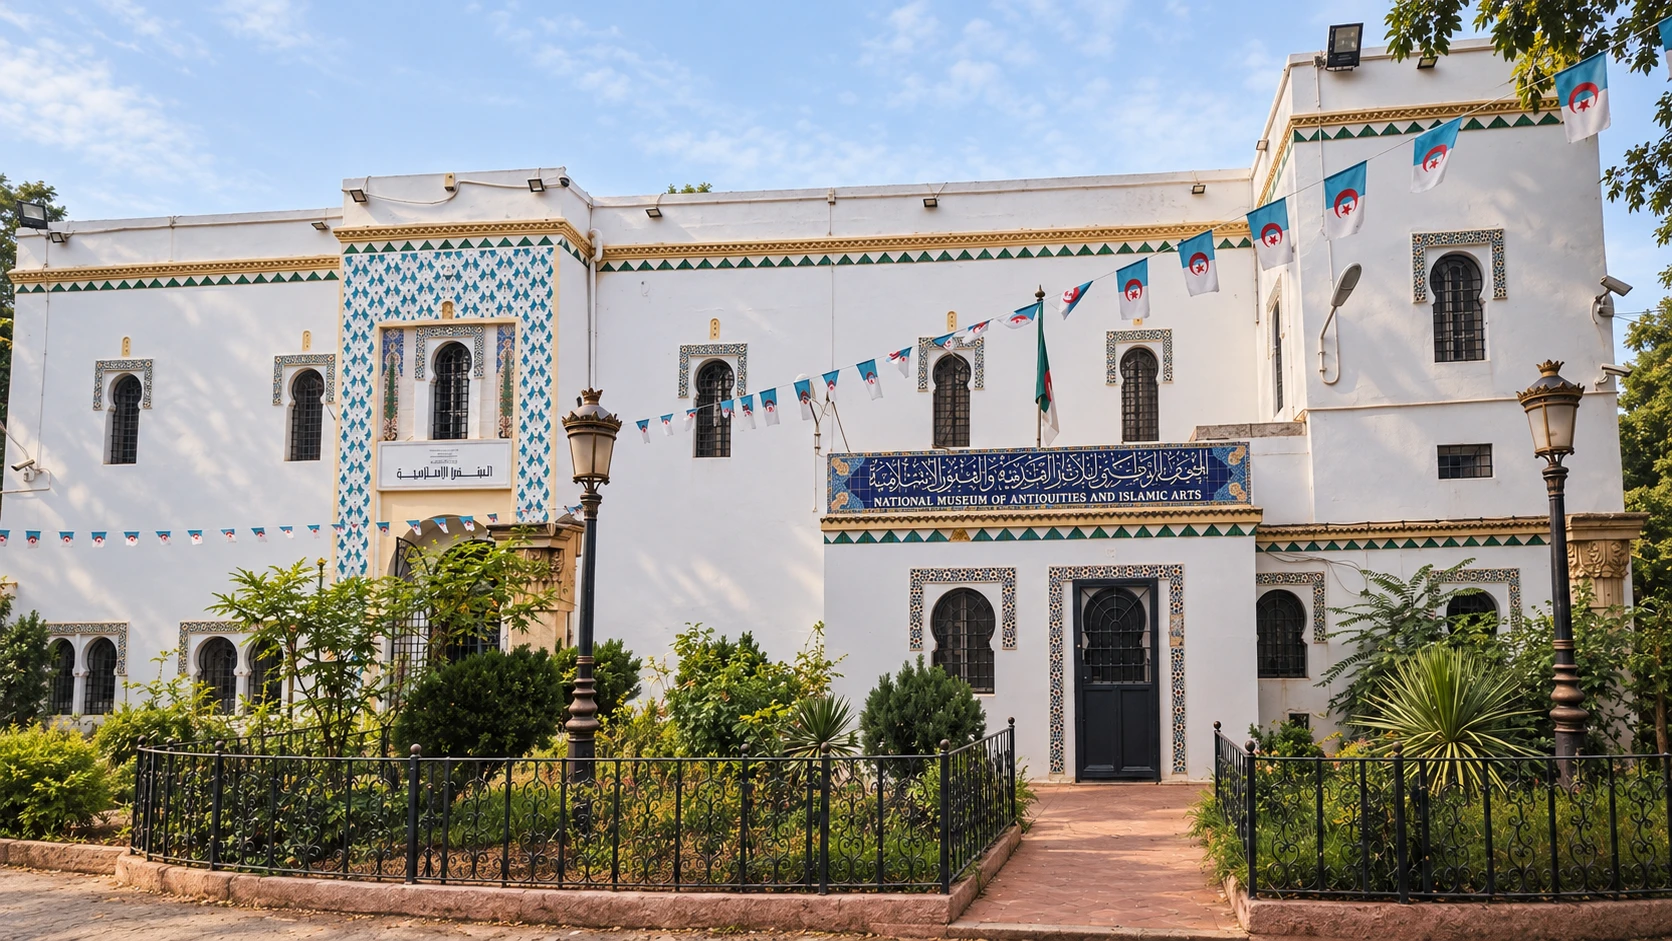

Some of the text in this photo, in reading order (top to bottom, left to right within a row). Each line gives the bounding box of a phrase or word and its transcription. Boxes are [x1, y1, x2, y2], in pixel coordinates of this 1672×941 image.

[874, 496, 934, 508] NATIONAL
[937, 494, 988, 506] MUSEUM
[991, 494, 1007, 505] OF
[1090, 491, 1116, 503] AND
[1118, 490, 1168, 502] ISLAMIC
[1171, 489, 1202, 501] ARTS
